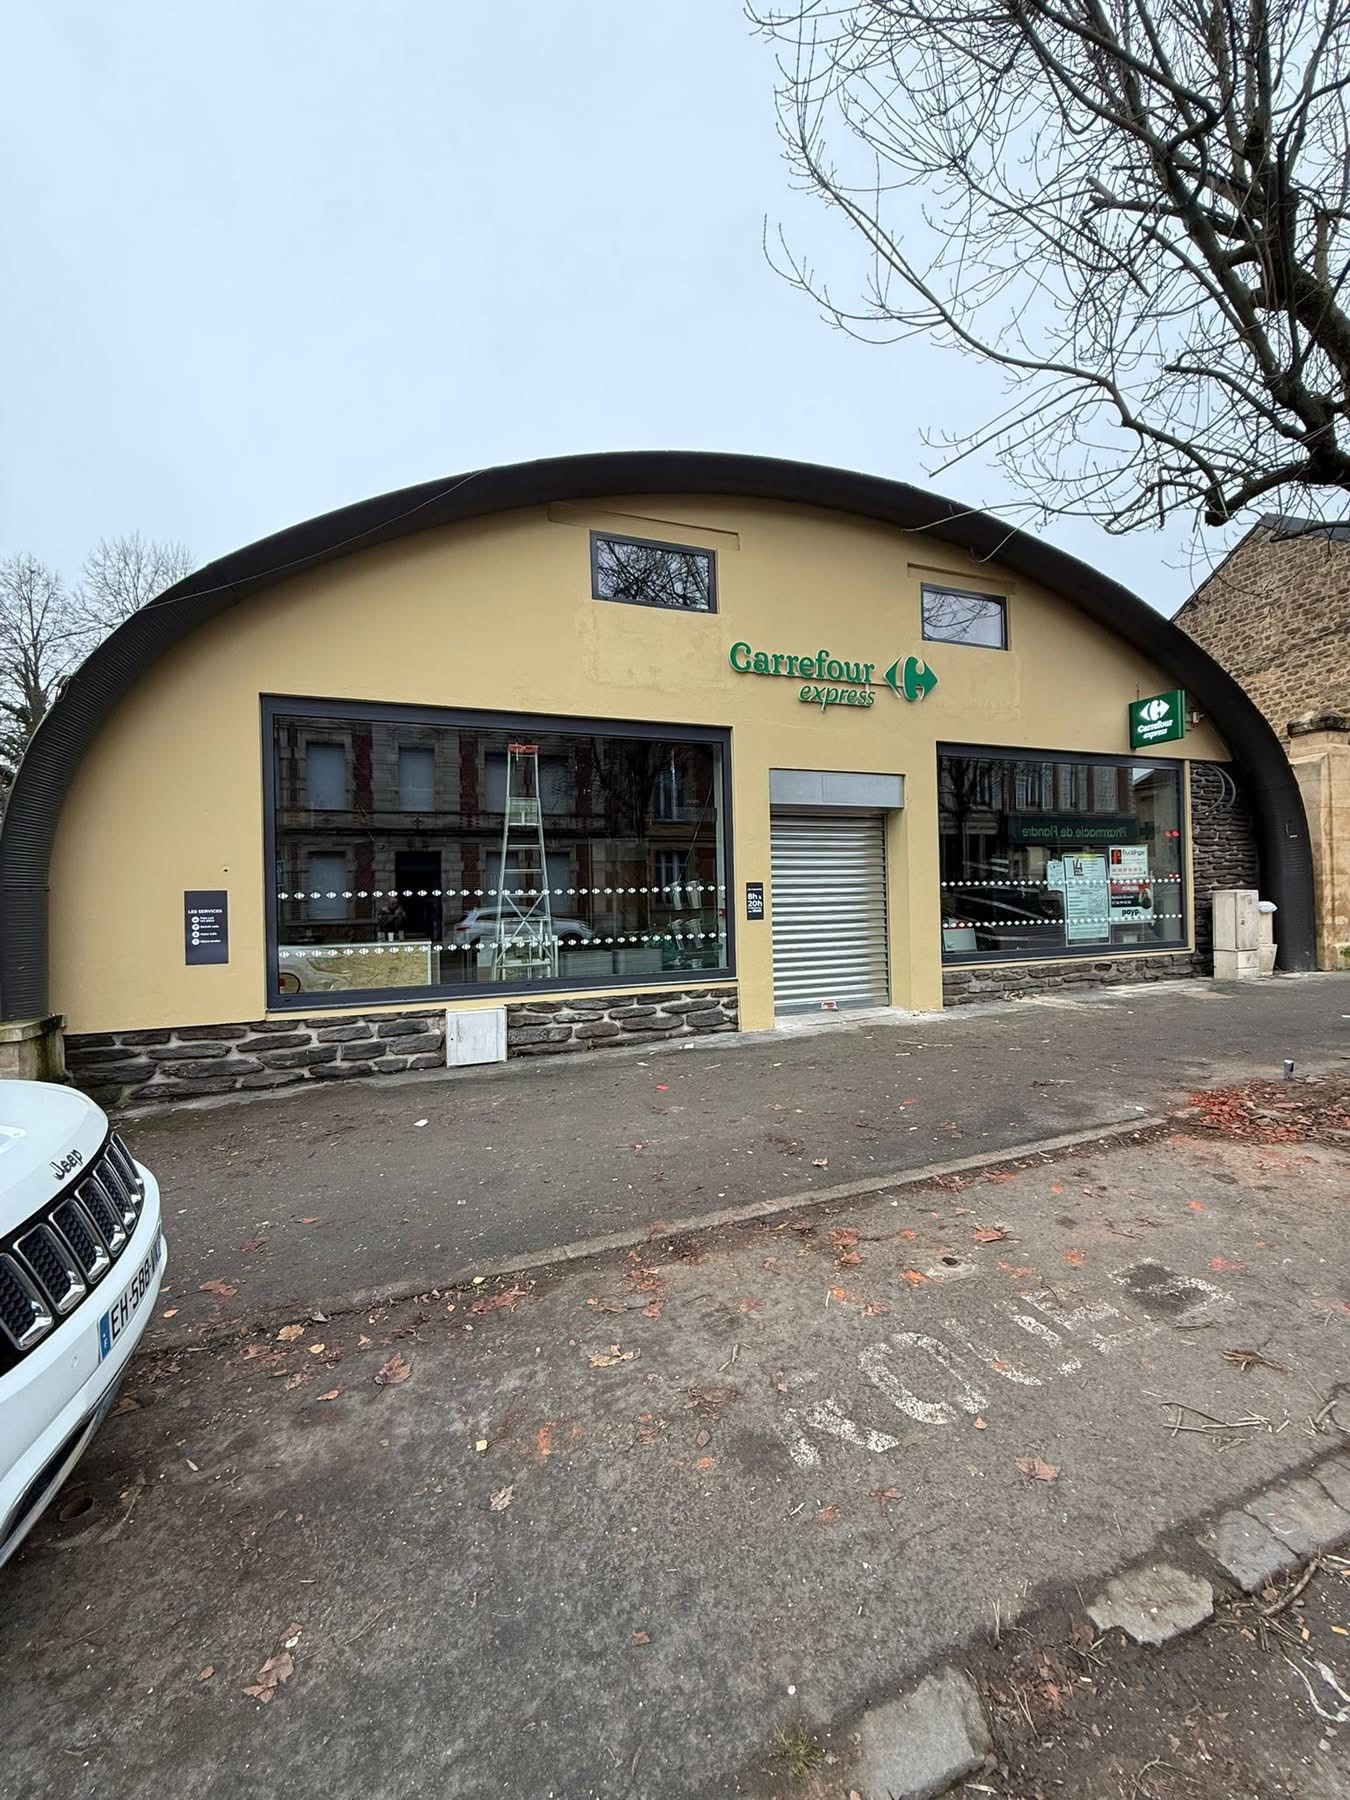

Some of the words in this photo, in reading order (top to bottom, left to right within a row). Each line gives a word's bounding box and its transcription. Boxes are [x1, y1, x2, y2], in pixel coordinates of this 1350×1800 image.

[729, 641, 876, 684] Carrefour
[799, 685, 876, 712] express
[49, 1149, 84, 1181] Jeep
